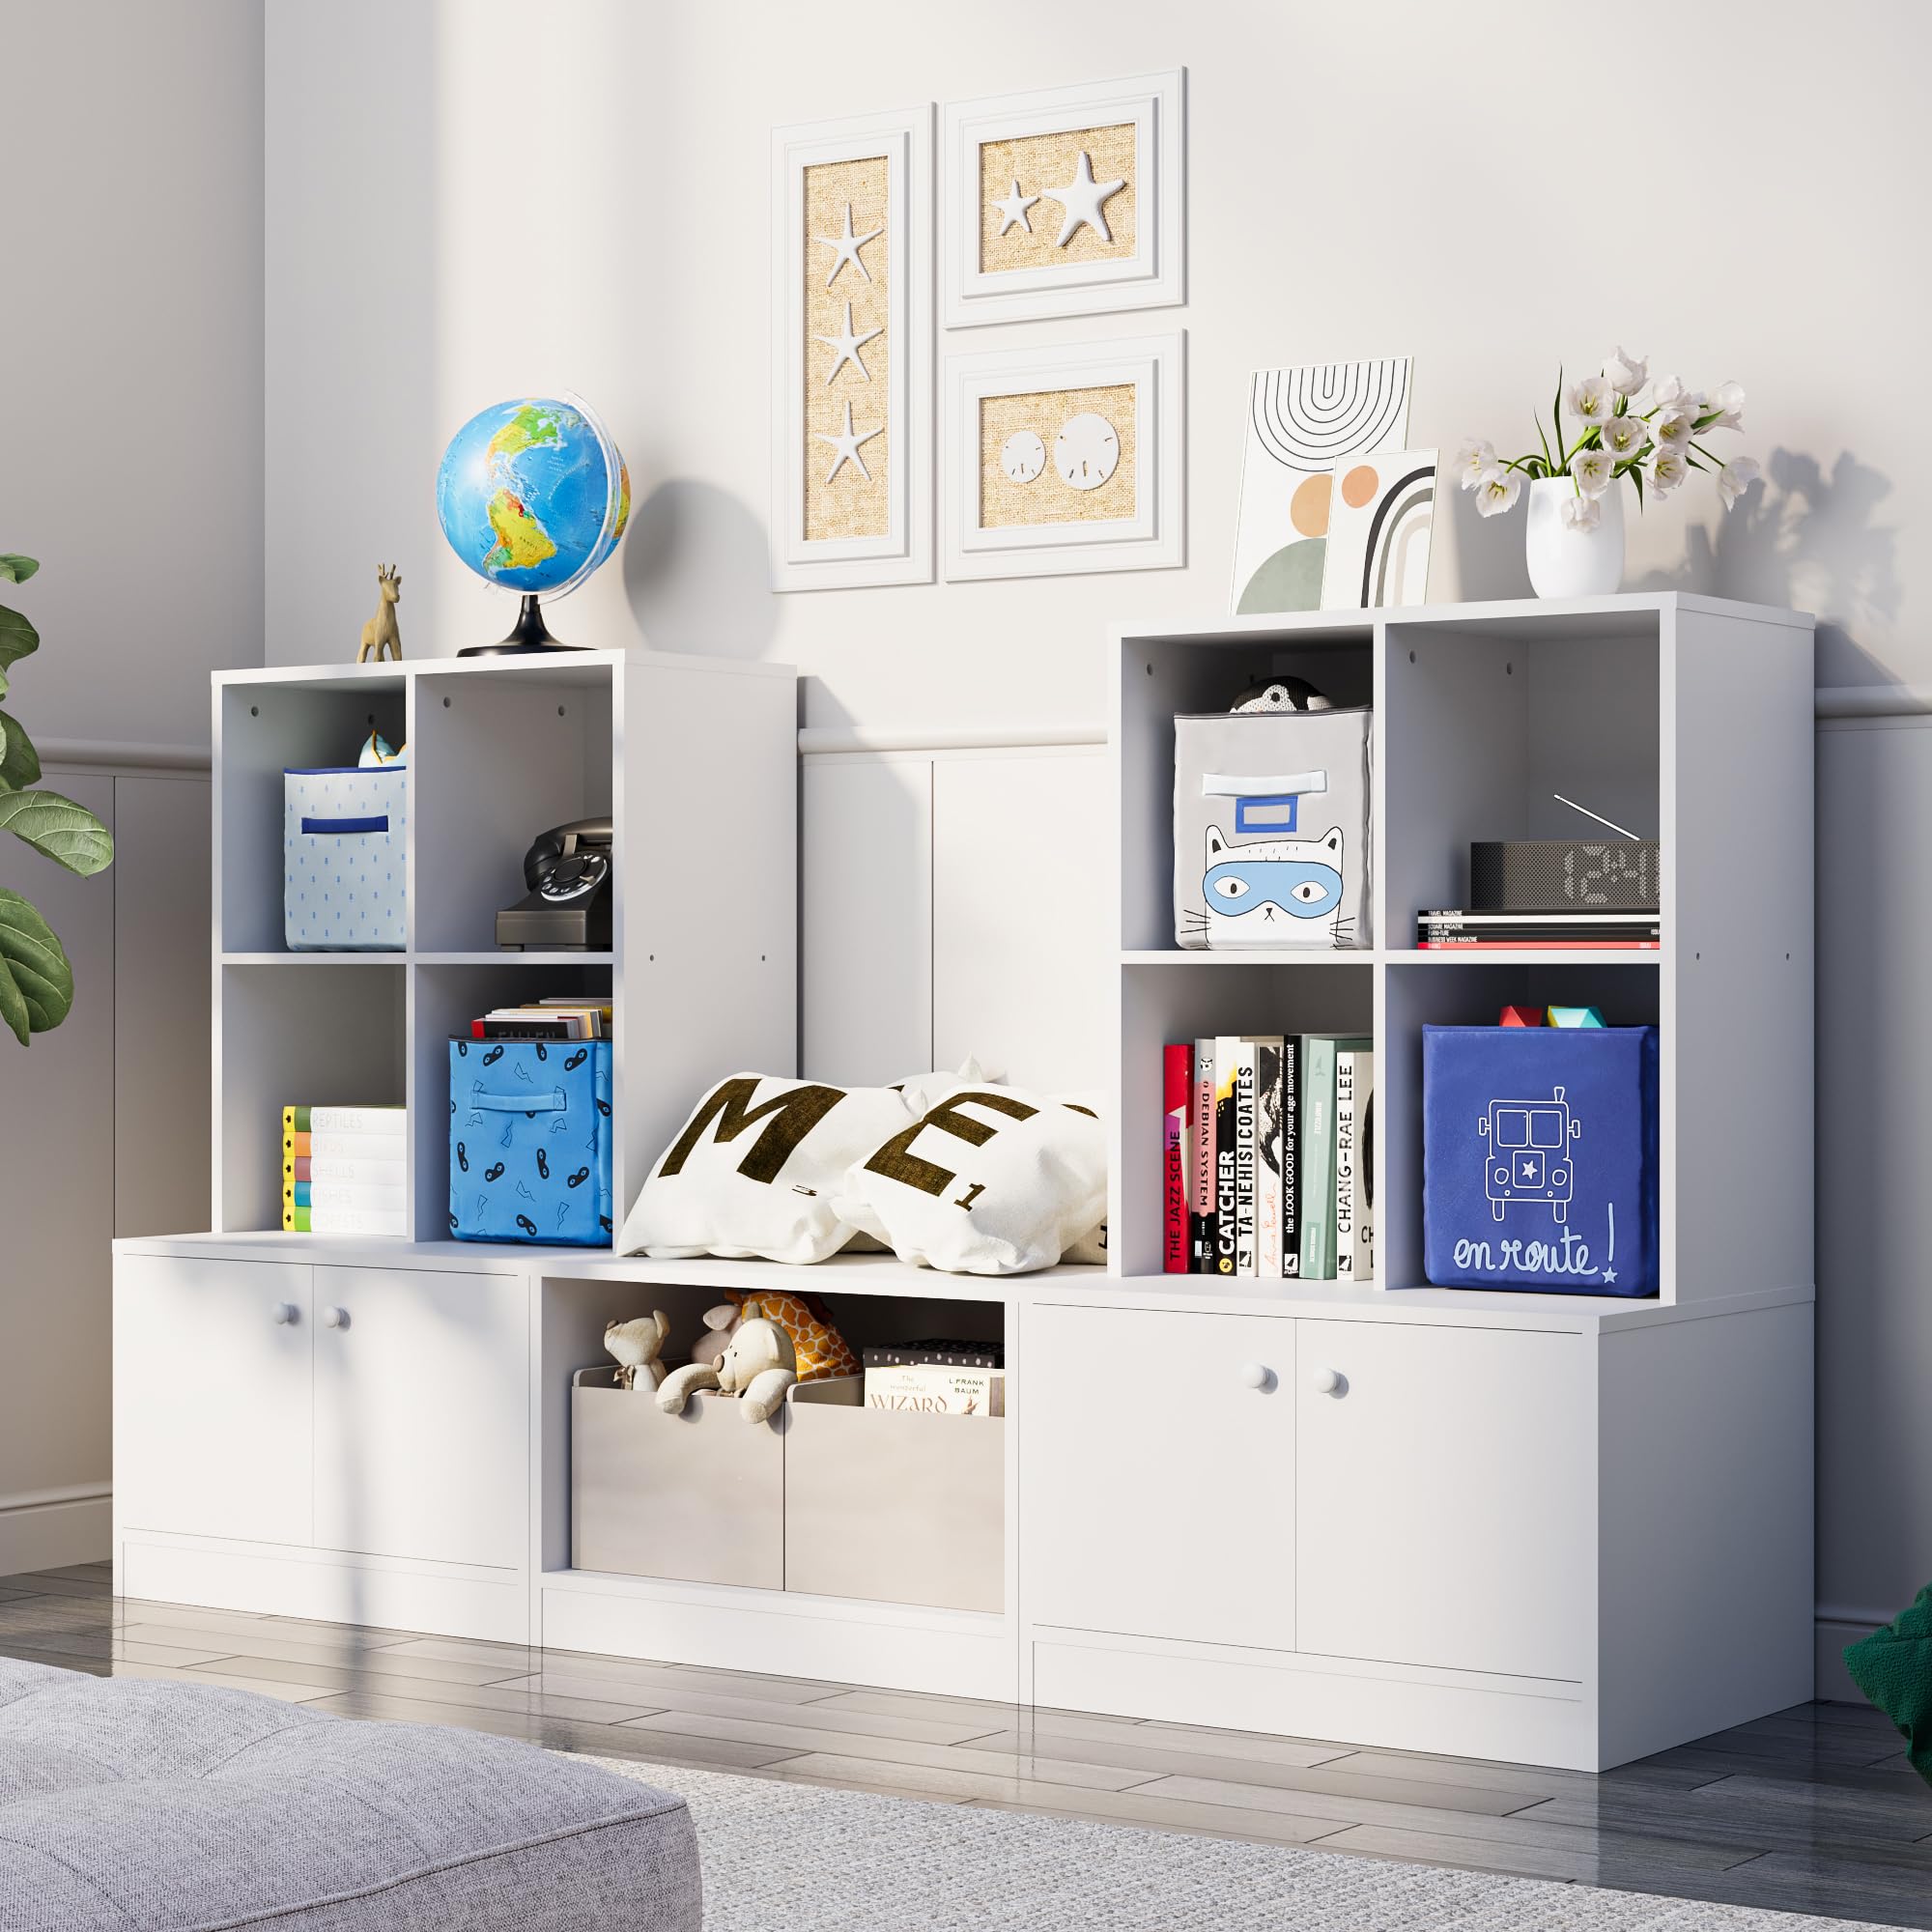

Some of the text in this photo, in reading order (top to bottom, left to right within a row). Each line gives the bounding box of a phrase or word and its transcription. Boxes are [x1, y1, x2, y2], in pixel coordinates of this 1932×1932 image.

[311, 1112, 363, 1129] REPTILES
[657, 1078, 848, 1184] M
[863, 1092, 1041, 1197] E
[1202, 1093, 1210, 1146] DEBIAN
[1237, 1066, 1254, 1236] TA-NEHISI COATES
[1285, 1044, 1296, 1234] the LOOK GOOD for your age movement
[1337, 1065, 1352, 1234] CHANG-RAE LEE
[952, 1182, 986, 1212] 1
[1169, 1131, 1180, 1261] THE JAZZ SCENE
[1200, 1151, 1208, 1206] SYSTEM
[1218, 1151, 1236, 1255] CATCHER
[1454, 1238, 1495, 1270] en
